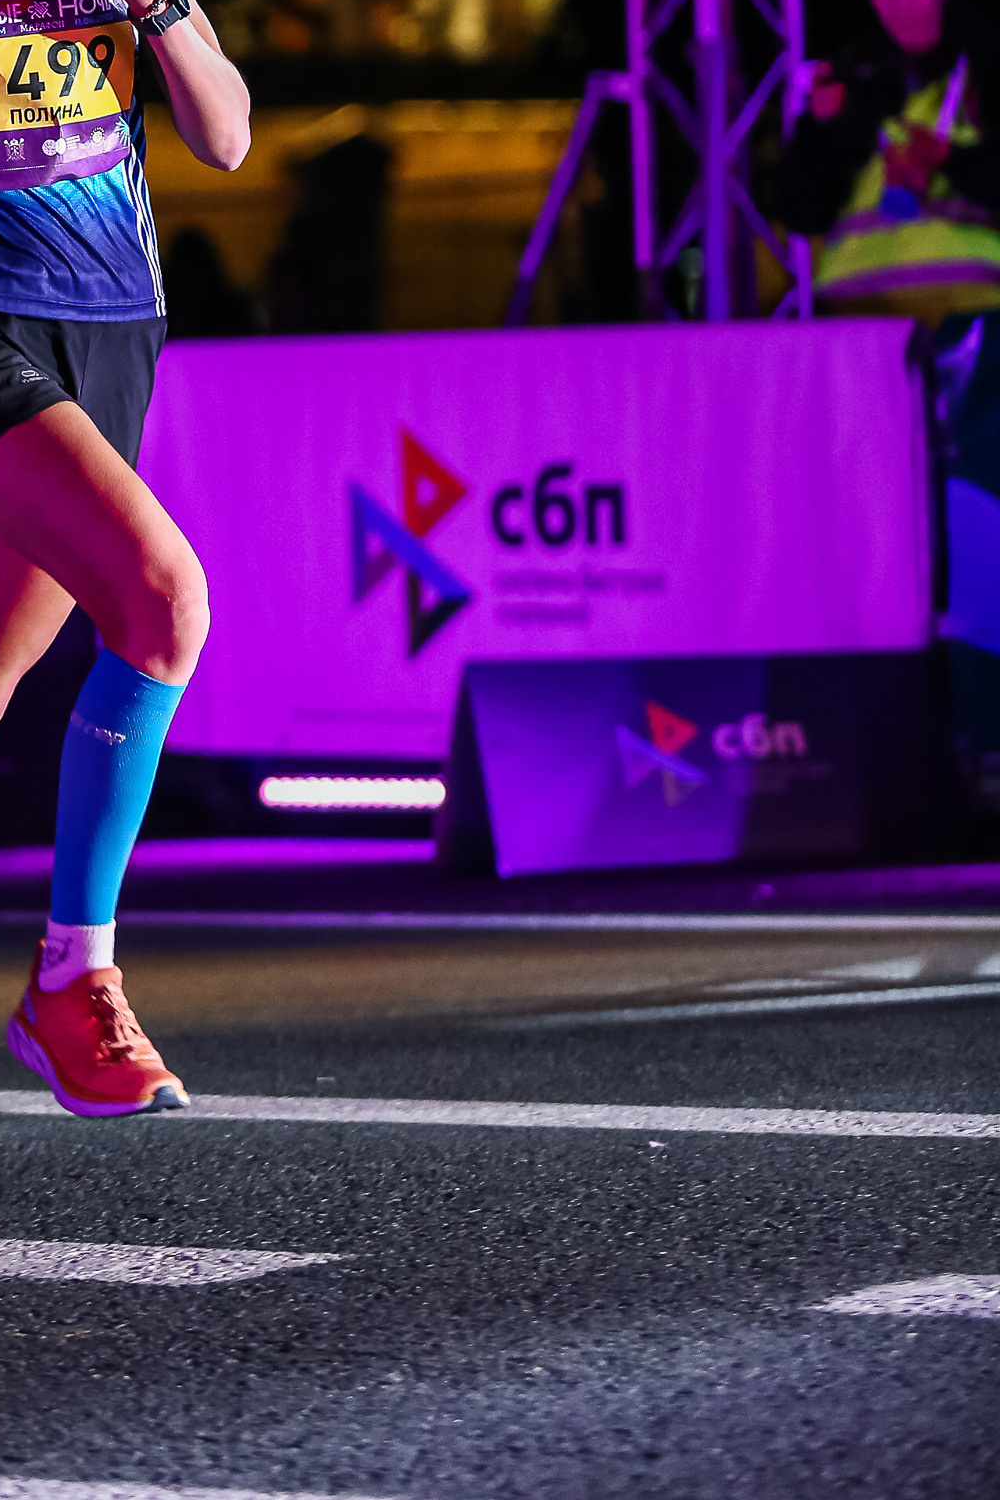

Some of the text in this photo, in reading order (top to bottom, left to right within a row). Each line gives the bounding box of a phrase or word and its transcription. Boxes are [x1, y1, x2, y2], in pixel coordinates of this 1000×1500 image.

[10, 102, 84, 125] ПОЛИНА
[491, 462, 625, 547] сбп
[711, 712, 807, 760] сбп
